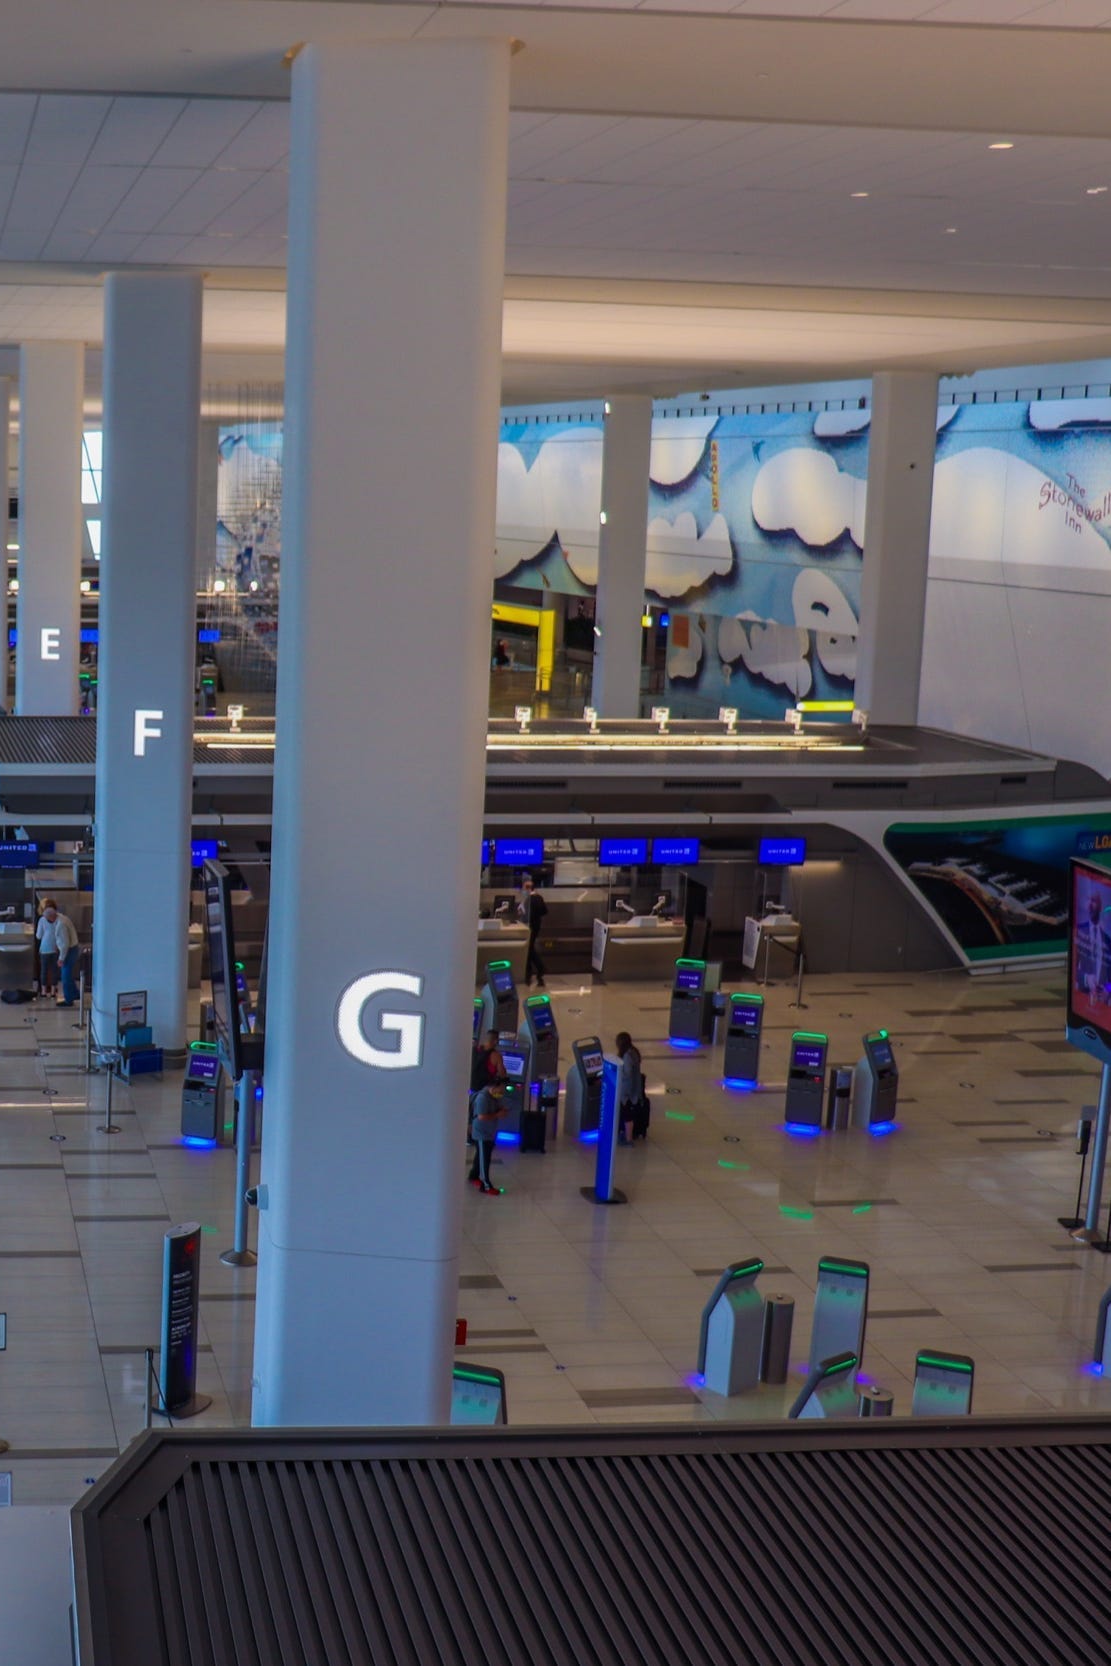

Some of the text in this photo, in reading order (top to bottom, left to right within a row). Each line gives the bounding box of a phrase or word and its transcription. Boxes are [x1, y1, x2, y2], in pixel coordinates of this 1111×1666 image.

[1066, 473, 1086, 498] The
[1065, 511, 1082, 533] Inn
[41, 628, 60, 660] E
[134, 709, 163, 756] F
[337, 970, 423, 1069] G
